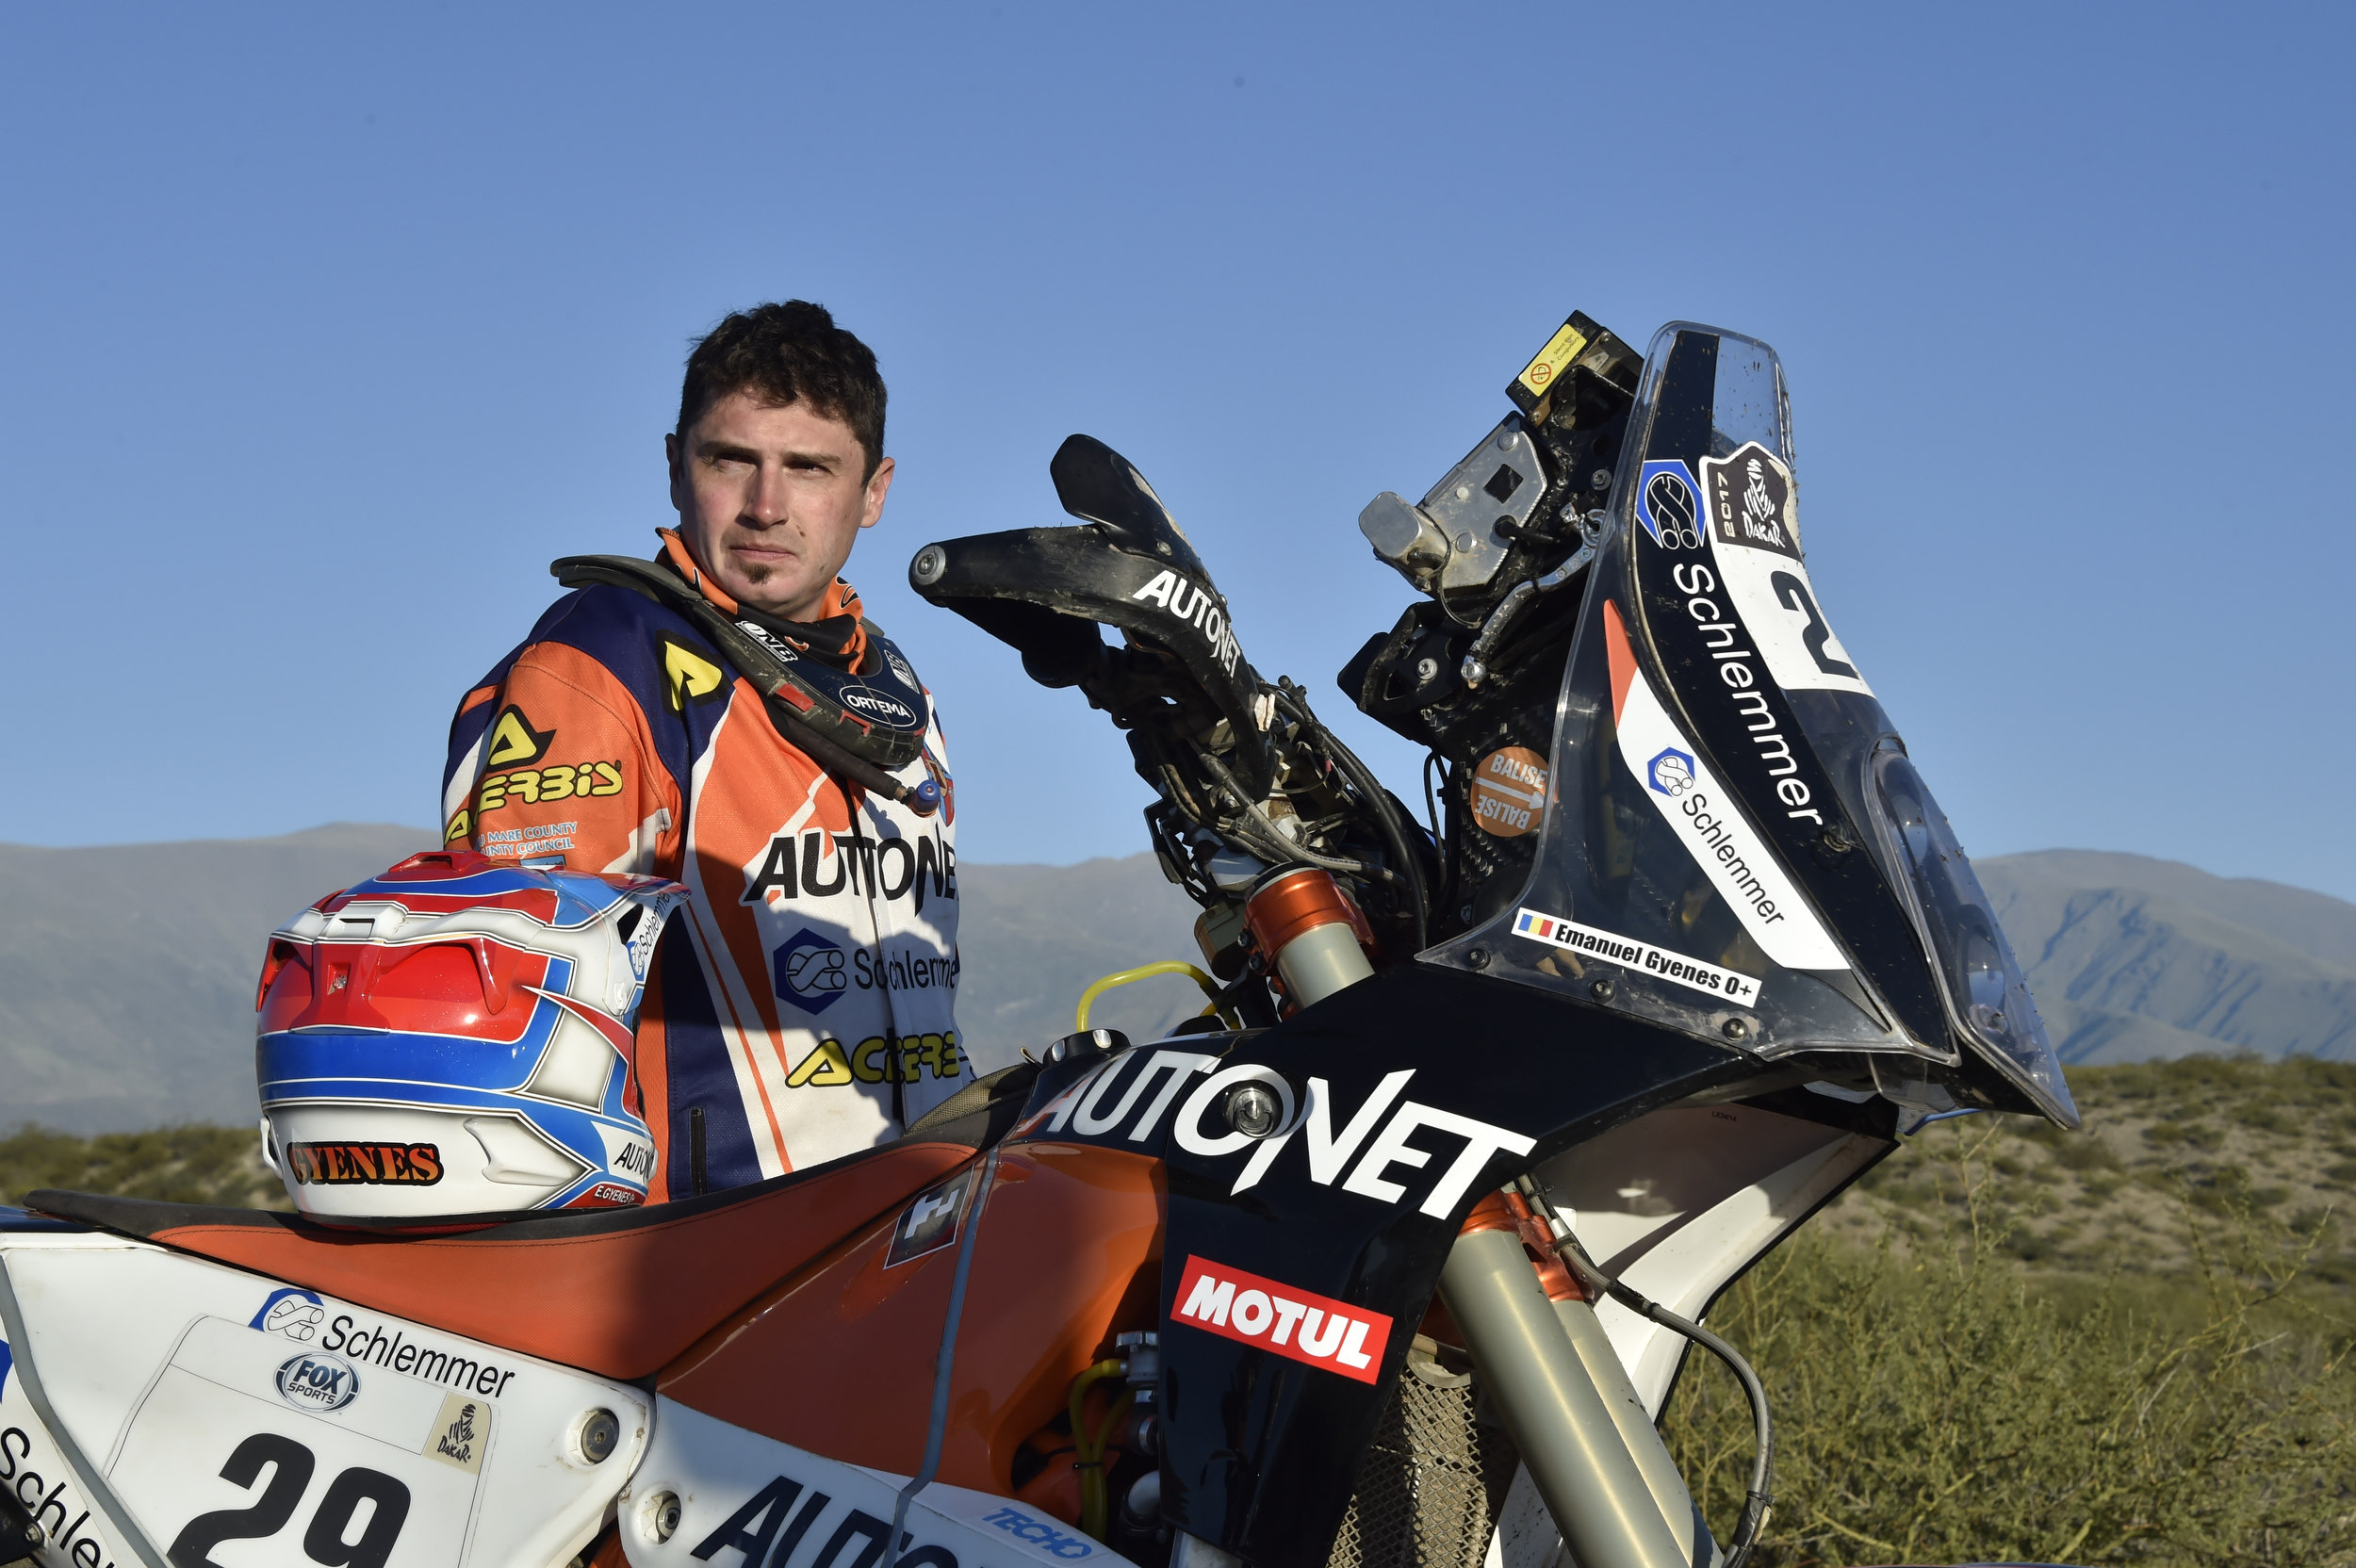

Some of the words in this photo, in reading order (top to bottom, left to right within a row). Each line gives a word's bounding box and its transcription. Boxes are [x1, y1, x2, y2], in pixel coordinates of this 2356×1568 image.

[1717, 471, 1736, 538] 2017
[1742, 510, 1786, 548] DAKAR
[1132, 569, 1241, 678] AUTONET
[846, 694, 912, 718] ORTEMA
[1673, 563, 1824, 825] Schlemmer
[1490, 754, 1548, 790] BALISE
[1475, 794, 1531, 829] BALISE
[487, 828, 522, 843] MARE
[524, 822, 578, 840] COUNTY
[518, 838, 575, 855] COUNCIL
[1681, 793, 1785, 928] Schlemmer
[1554, 923, 1644, 964] Emanuel
[1644, 951, 1721, 989] Gyenes
[1018, 1050, 1537, 1220] AUTONET
[287, 1144, 441, 1183] GYENES
[1181, 1275, 1371, 1370] MOTUL
[321, 1315, 515, 1398] Schlemmer
[286, 1381, 336, 1405] SPORTS
[292, 1359, 348, 1396] FOX
[436, 1435, 468, 1463] DAKAR
[167, 1432, 412, 1568] 29
